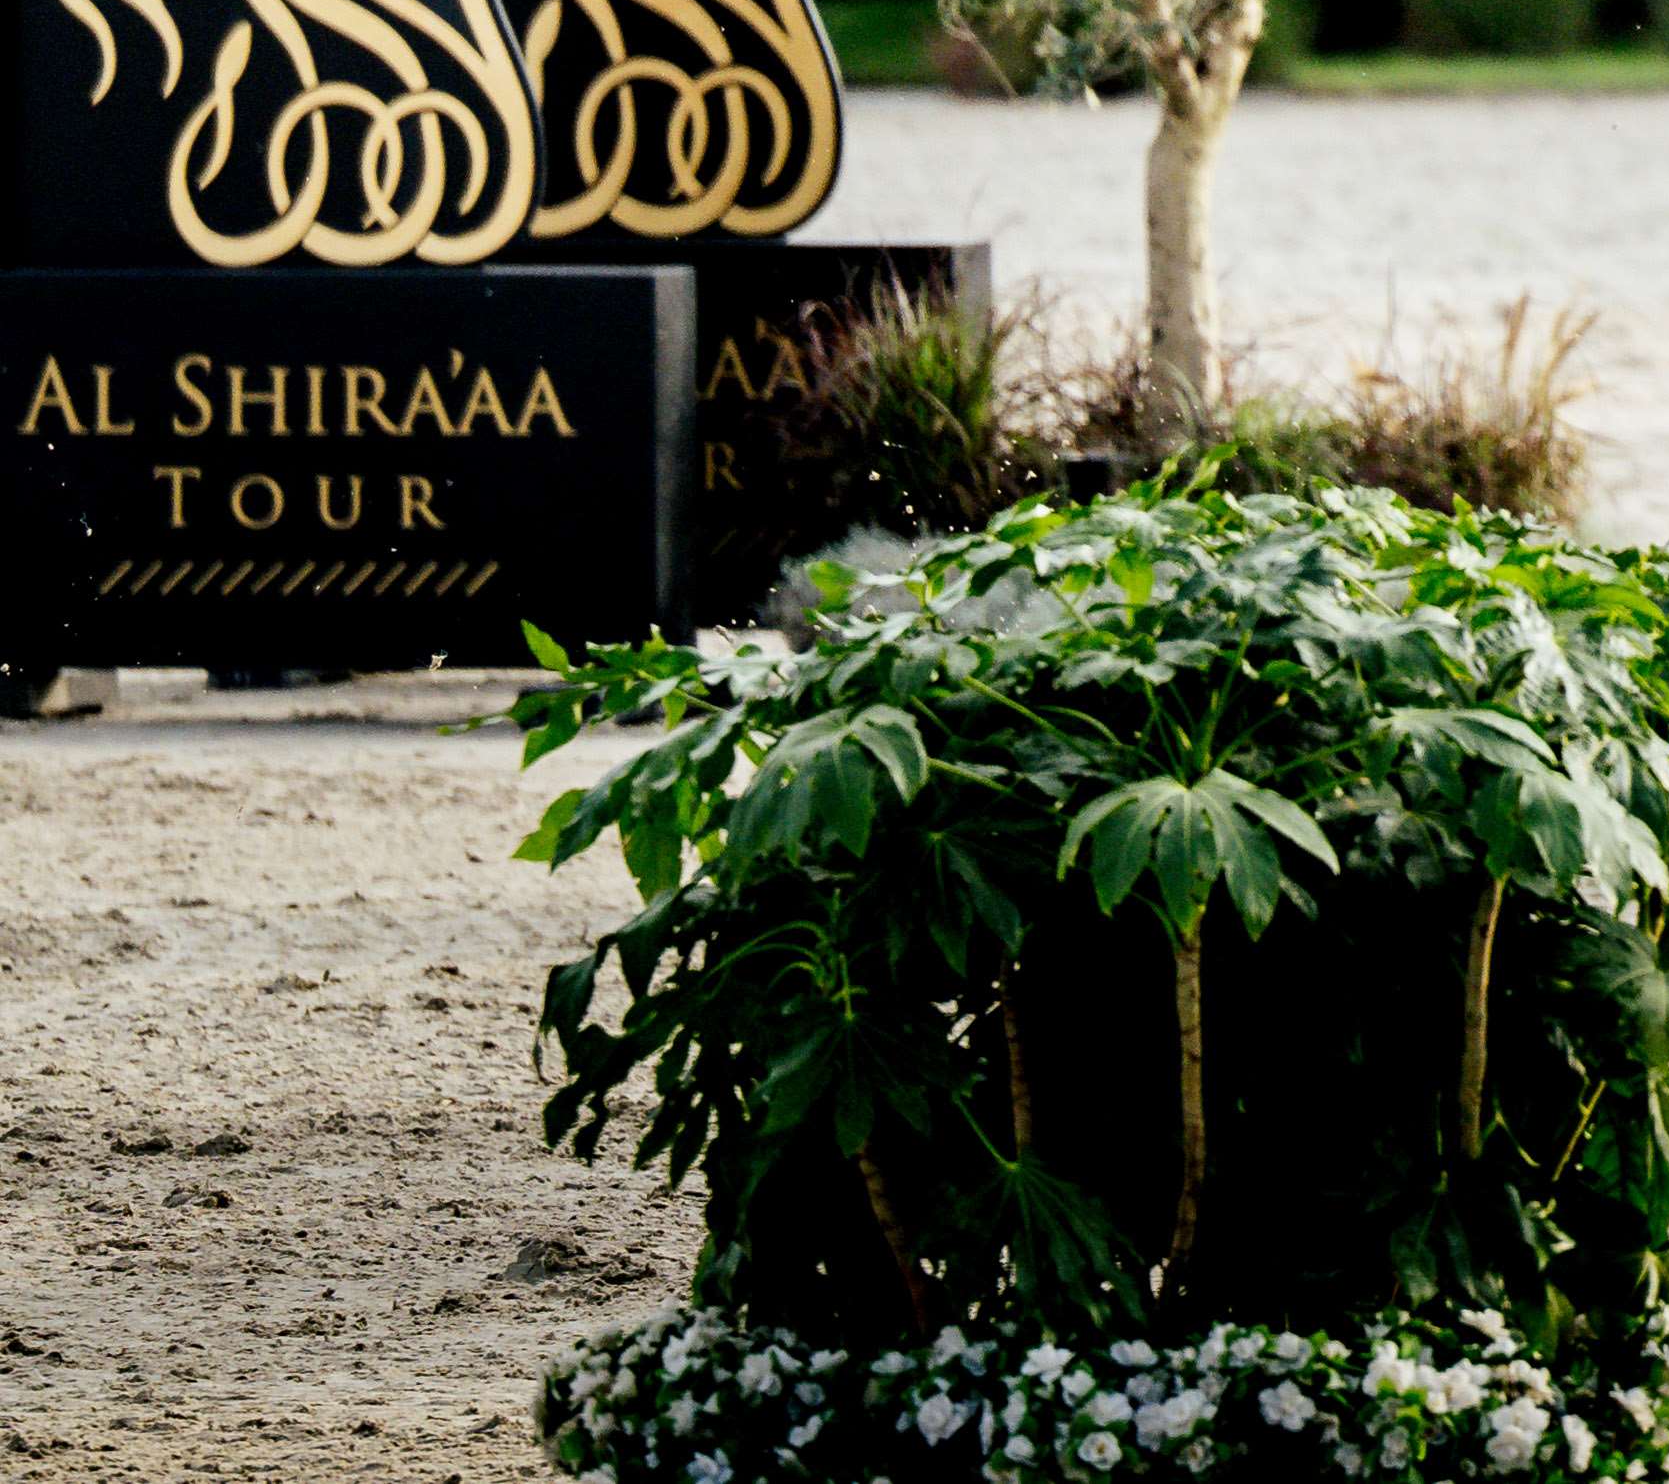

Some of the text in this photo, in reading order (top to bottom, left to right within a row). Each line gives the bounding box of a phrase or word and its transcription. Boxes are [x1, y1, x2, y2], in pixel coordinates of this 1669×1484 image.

[20, 347, 577, 437] AL SHIRA'AA
[154, 466, 445, 529] TOUR
